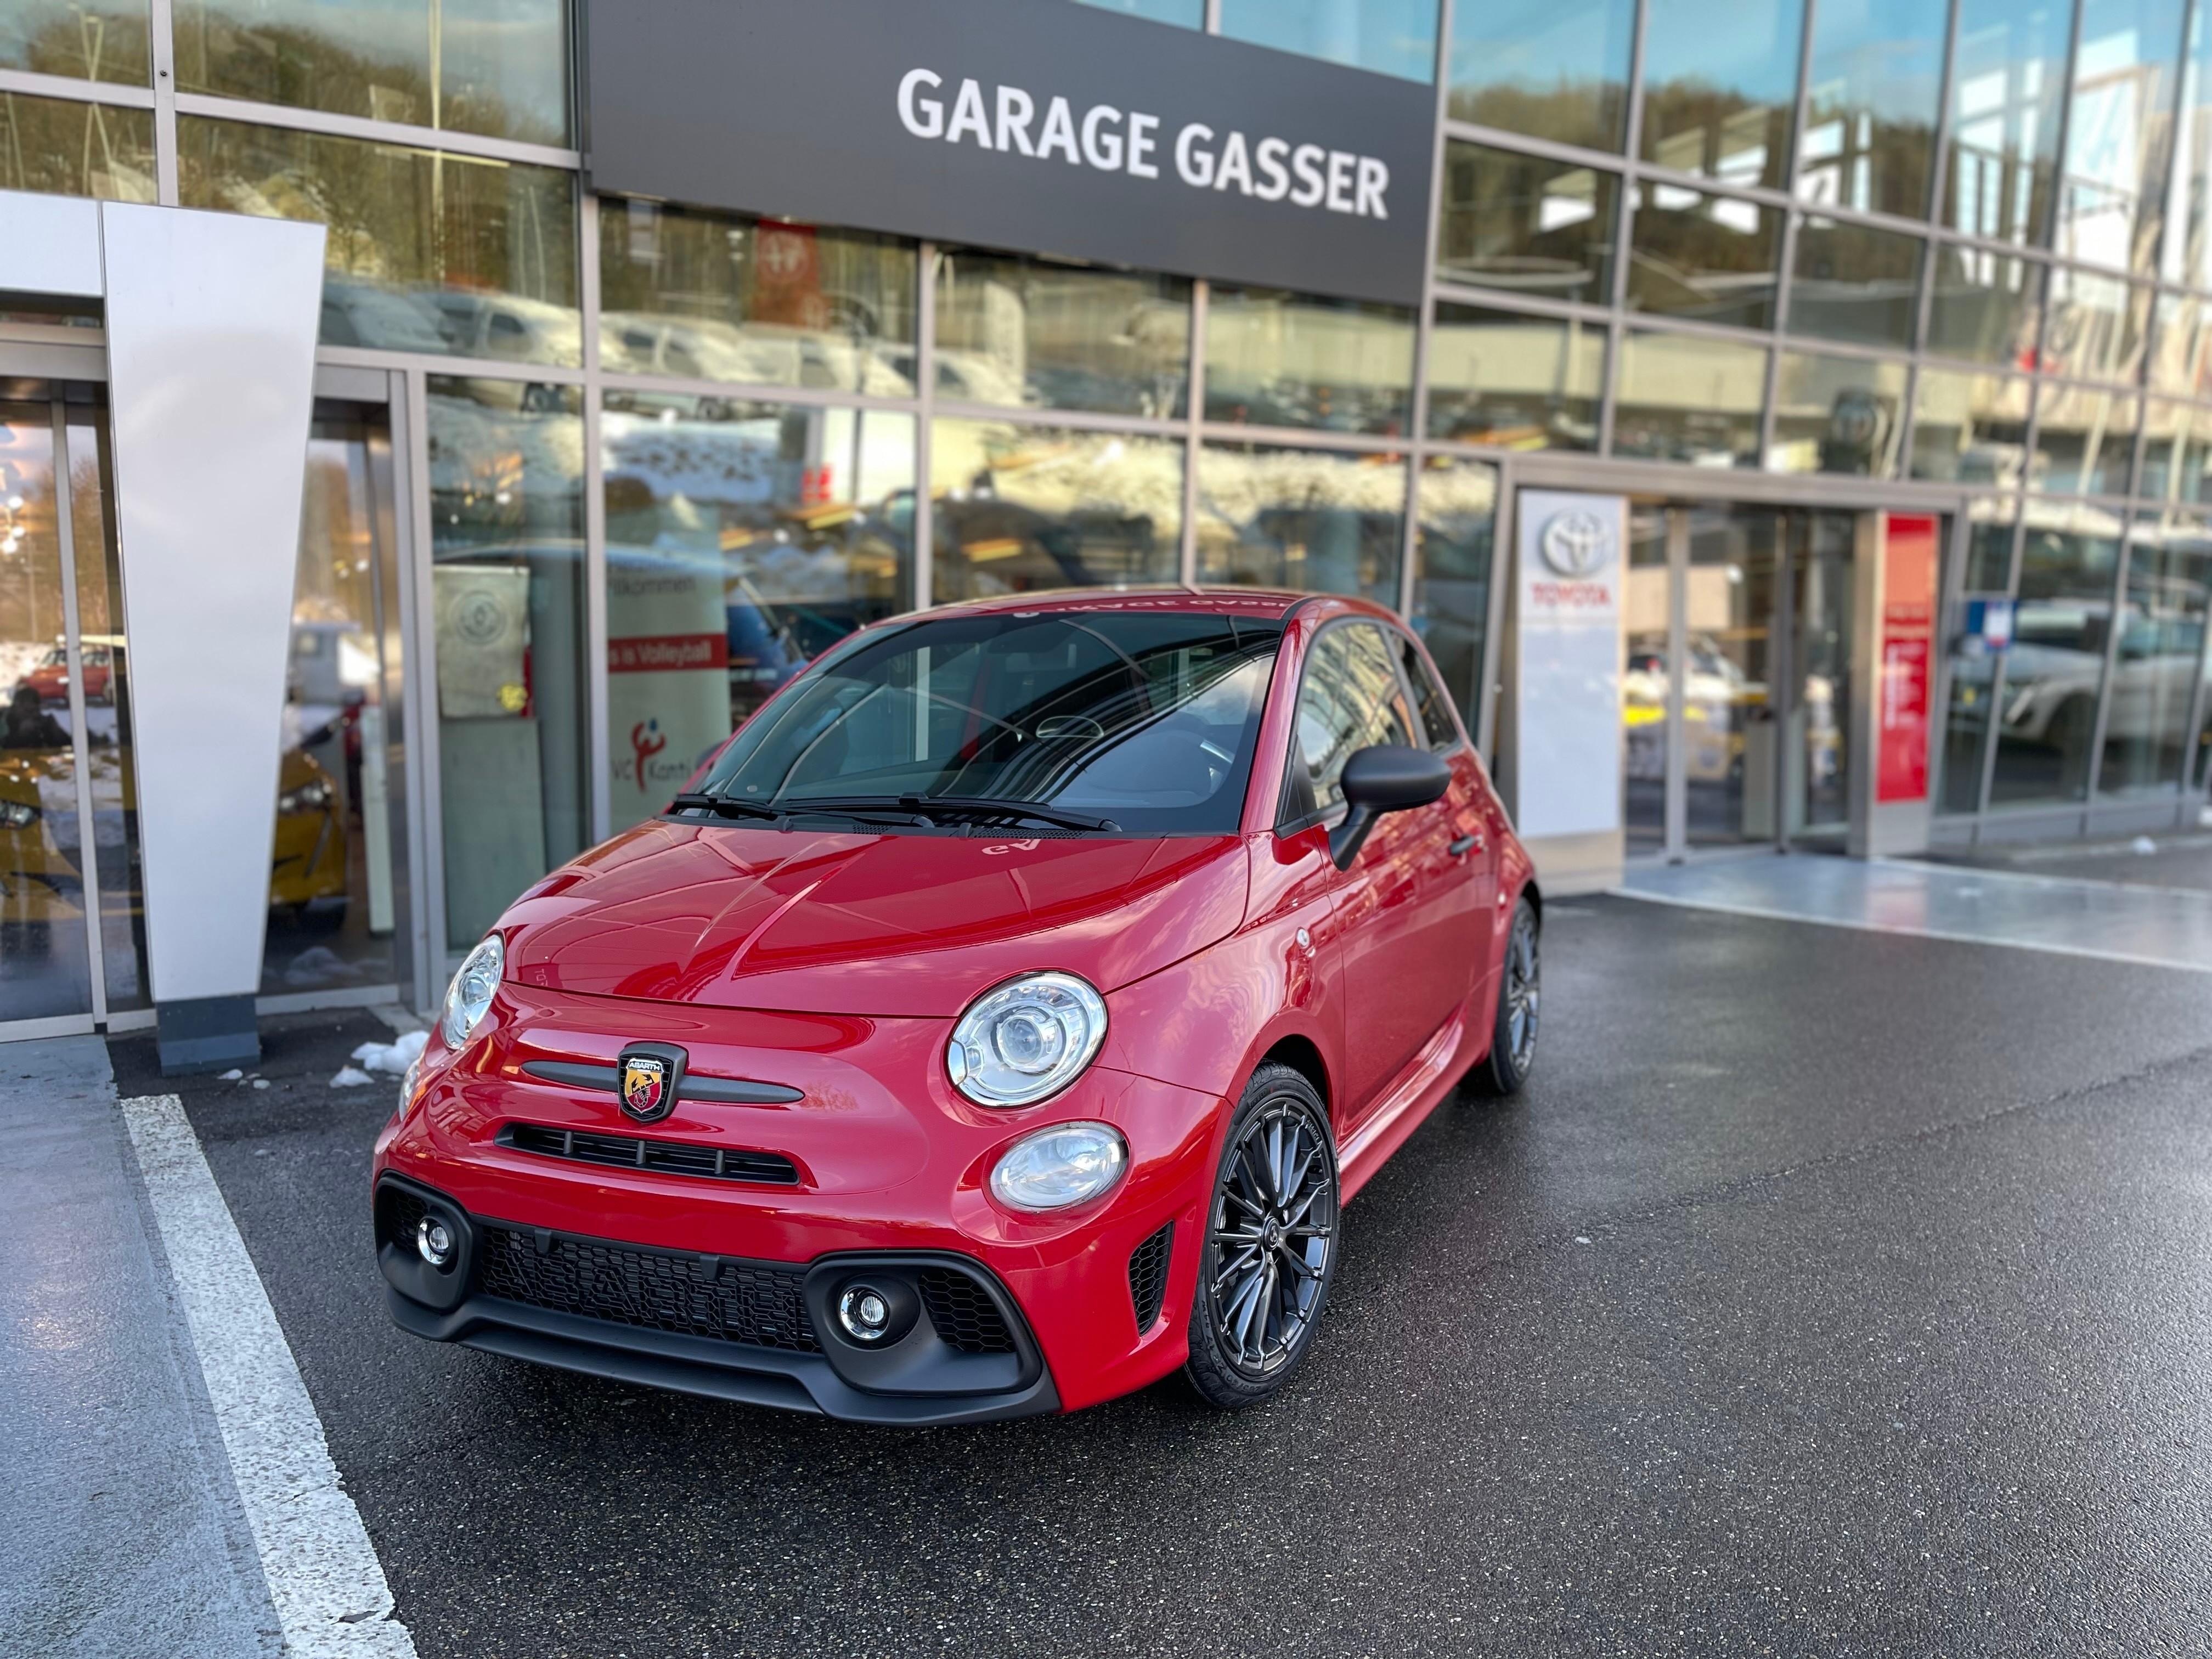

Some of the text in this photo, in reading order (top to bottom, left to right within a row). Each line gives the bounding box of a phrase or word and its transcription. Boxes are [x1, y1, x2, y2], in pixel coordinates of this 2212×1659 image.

[896, 67, 1389, 220] GARAGE GASSER
[1531, 583, 1611, 607] TOYOTA
[637, 639, 712, 667] Volleyball
[629, 1062, 661, 1070] ABARTH
[485, 1249, 799, 1340] ABARTH
